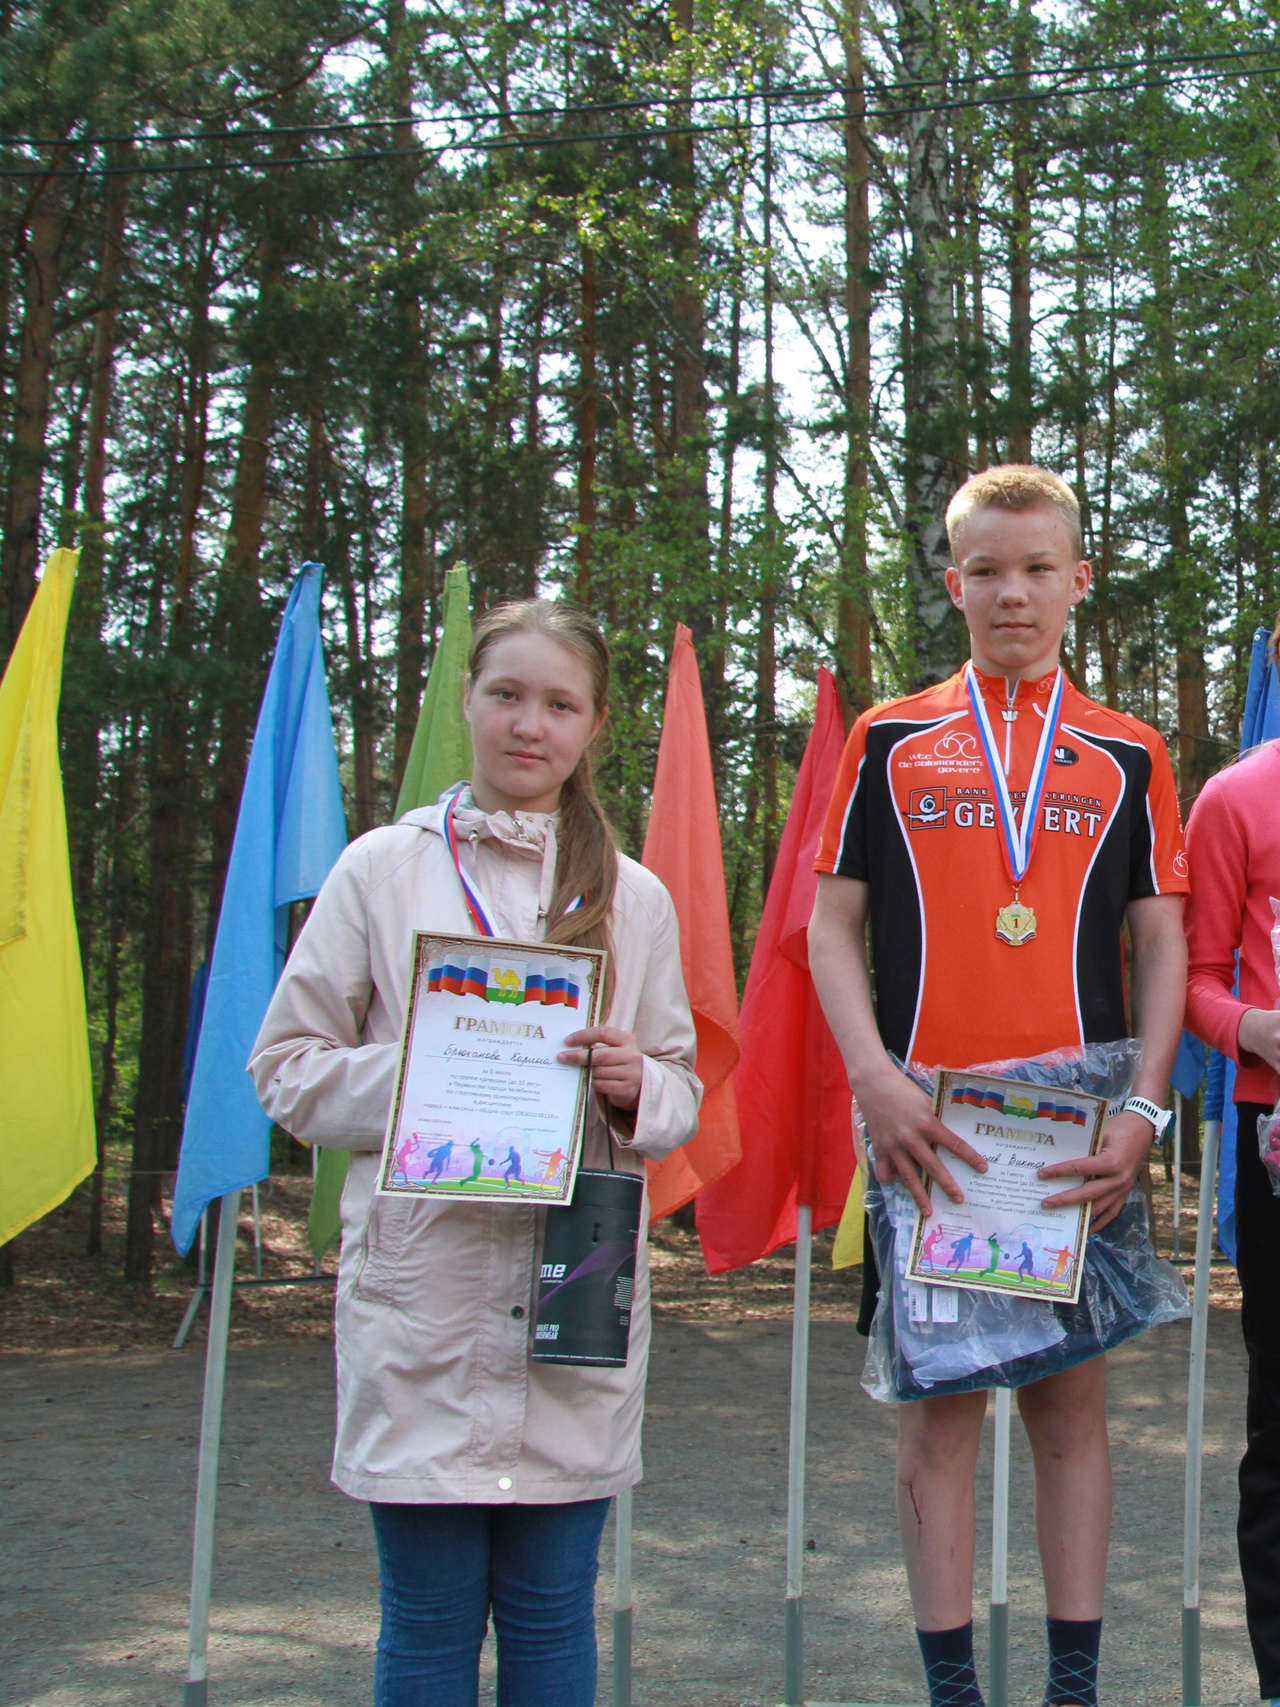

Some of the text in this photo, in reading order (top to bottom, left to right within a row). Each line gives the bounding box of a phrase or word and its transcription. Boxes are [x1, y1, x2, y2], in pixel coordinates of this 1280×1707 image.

[956, 787, 1102, 807] BANK VERKERINGEN
[953, 801, 1102, 838] GEERT
[1012, 918, 1019, 929] 1
[455, 1016, 545, 1039] ГРАМОТА
[477, 1038, 523, 1046] награждается
[443, 1043, 552, 1067] Брюханова Карина
[508, 1087, 541, 1095] Челябинска
[975, 1123, 1055, 1145] ГРАМОТА
[995, 1142, 1036, 1151] награждается
[974, 1181, 1002, 1189] Первенстве
[1021, 1187, 1050, 1195] Челябинска
